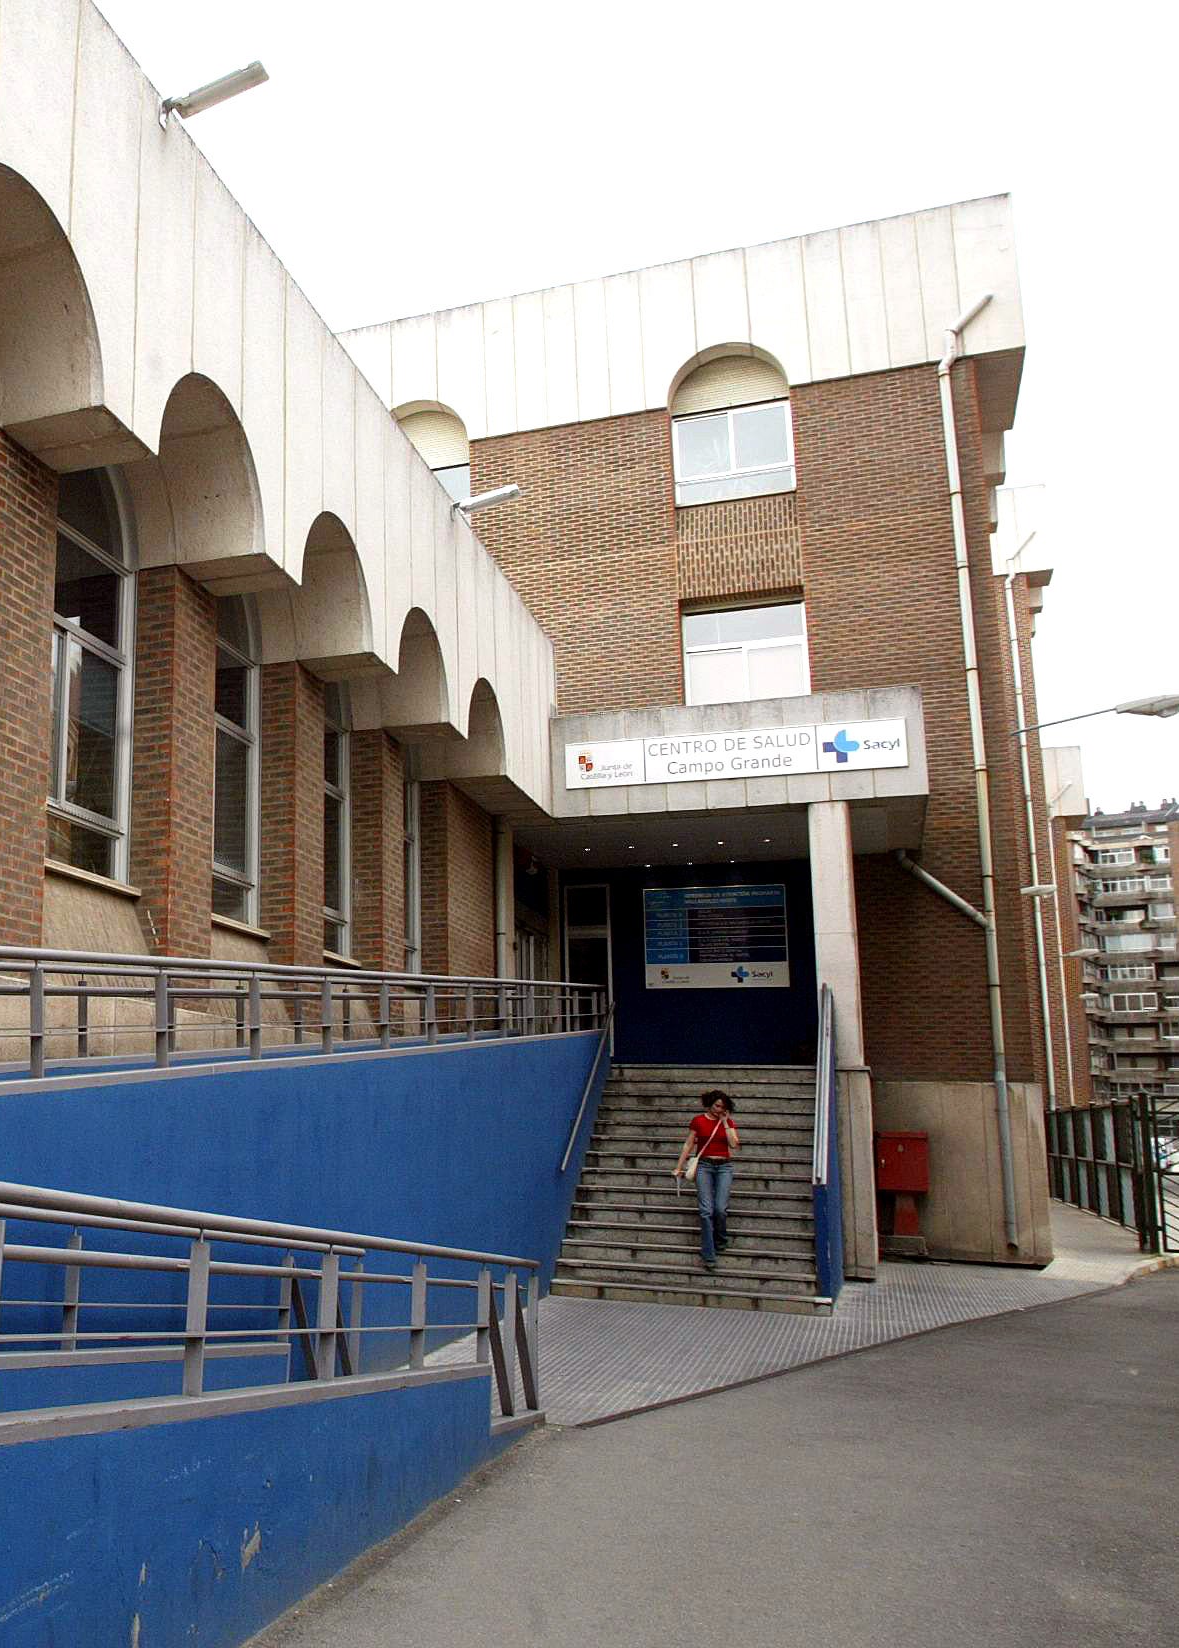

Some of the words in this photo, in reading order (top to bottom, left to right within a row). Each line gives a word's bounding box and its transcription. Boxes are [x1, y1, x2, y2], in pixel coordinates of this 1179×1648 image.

[648, 739, 717, 757] CENTRO
[724, 737, 747, 752] DE
[752, 732, 811, 750] SALUD
[863, 737, 900, 751] Sacyl
[667, 761, 725, 775] Campo
[730, 754, 793, 770] Grande
